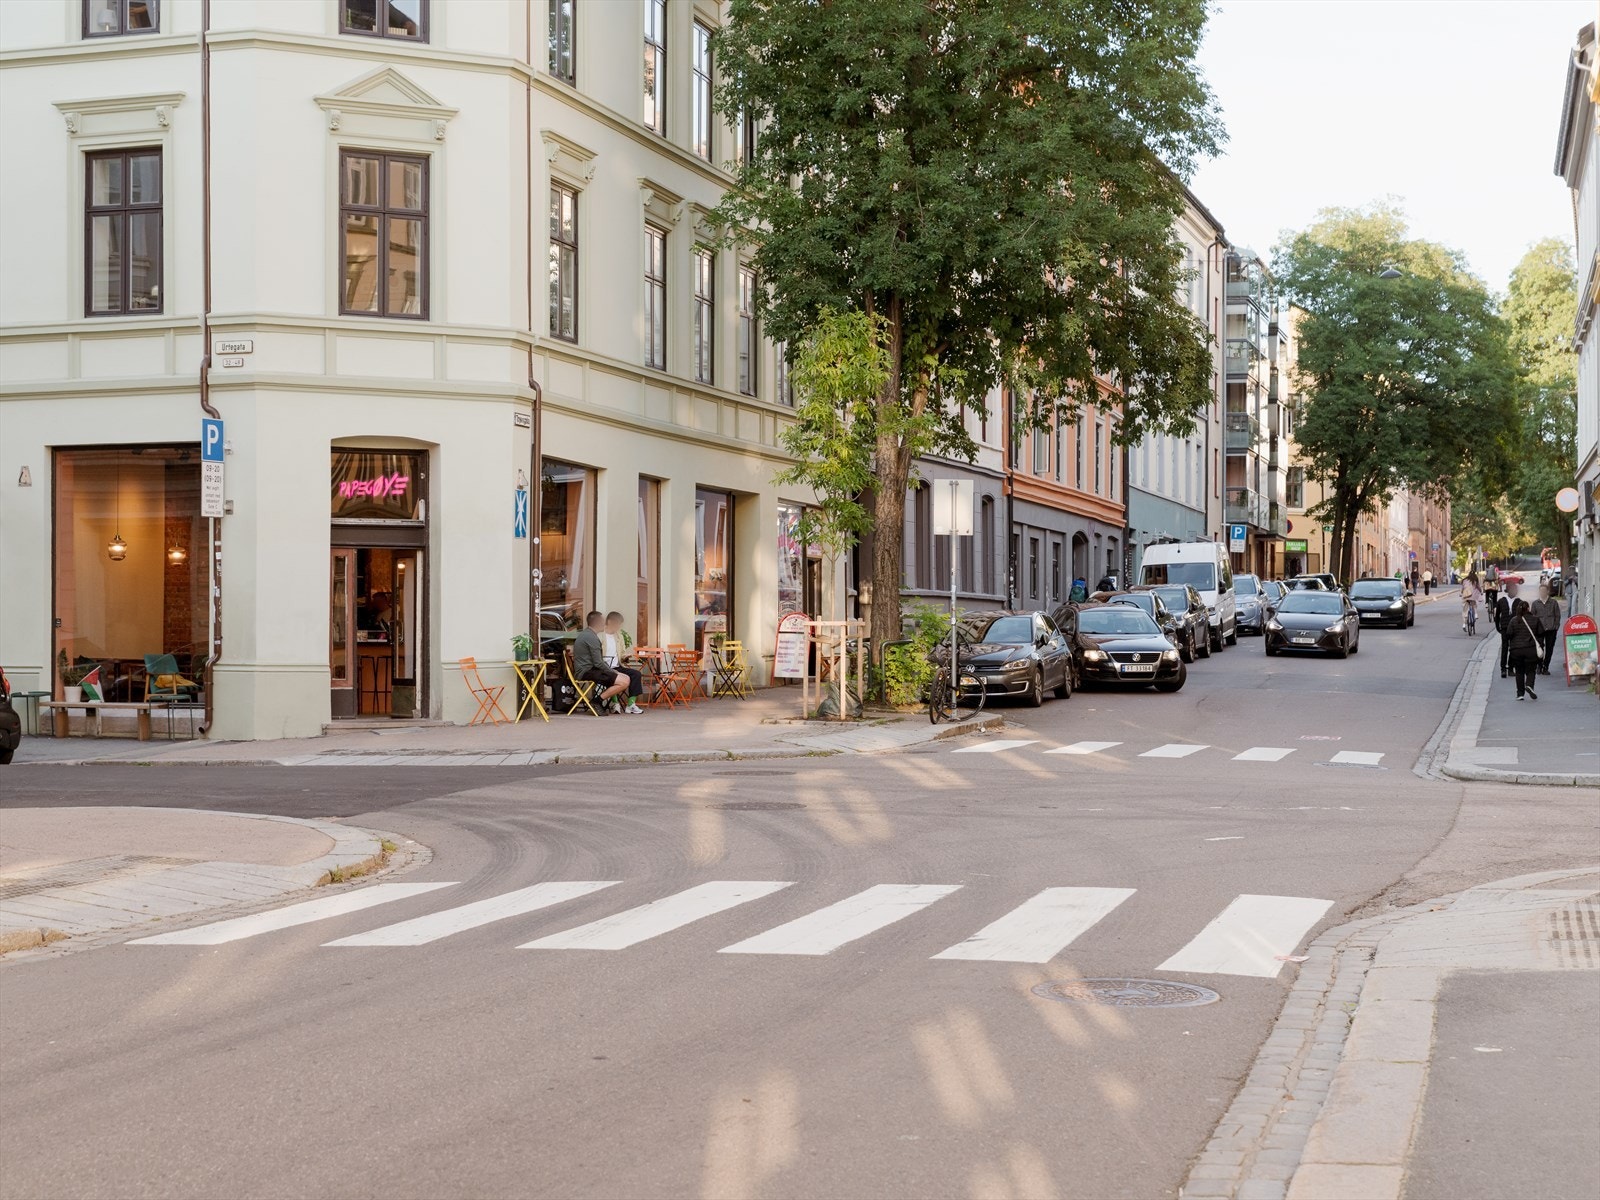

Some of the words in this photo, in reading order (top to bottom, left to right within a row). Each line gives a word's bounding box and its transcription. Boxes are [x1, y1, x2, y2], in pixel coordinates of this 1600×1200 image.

[222, 344, 245, 352] Urtegata
[207, 424, 219, 455] P
[206, 464, 220, 472] 09-20
[204, 475, 222, 483] (09-20)
[339, 471, 409, 499] PAPEGØYE
[1234, 526, 1242, 538] P
